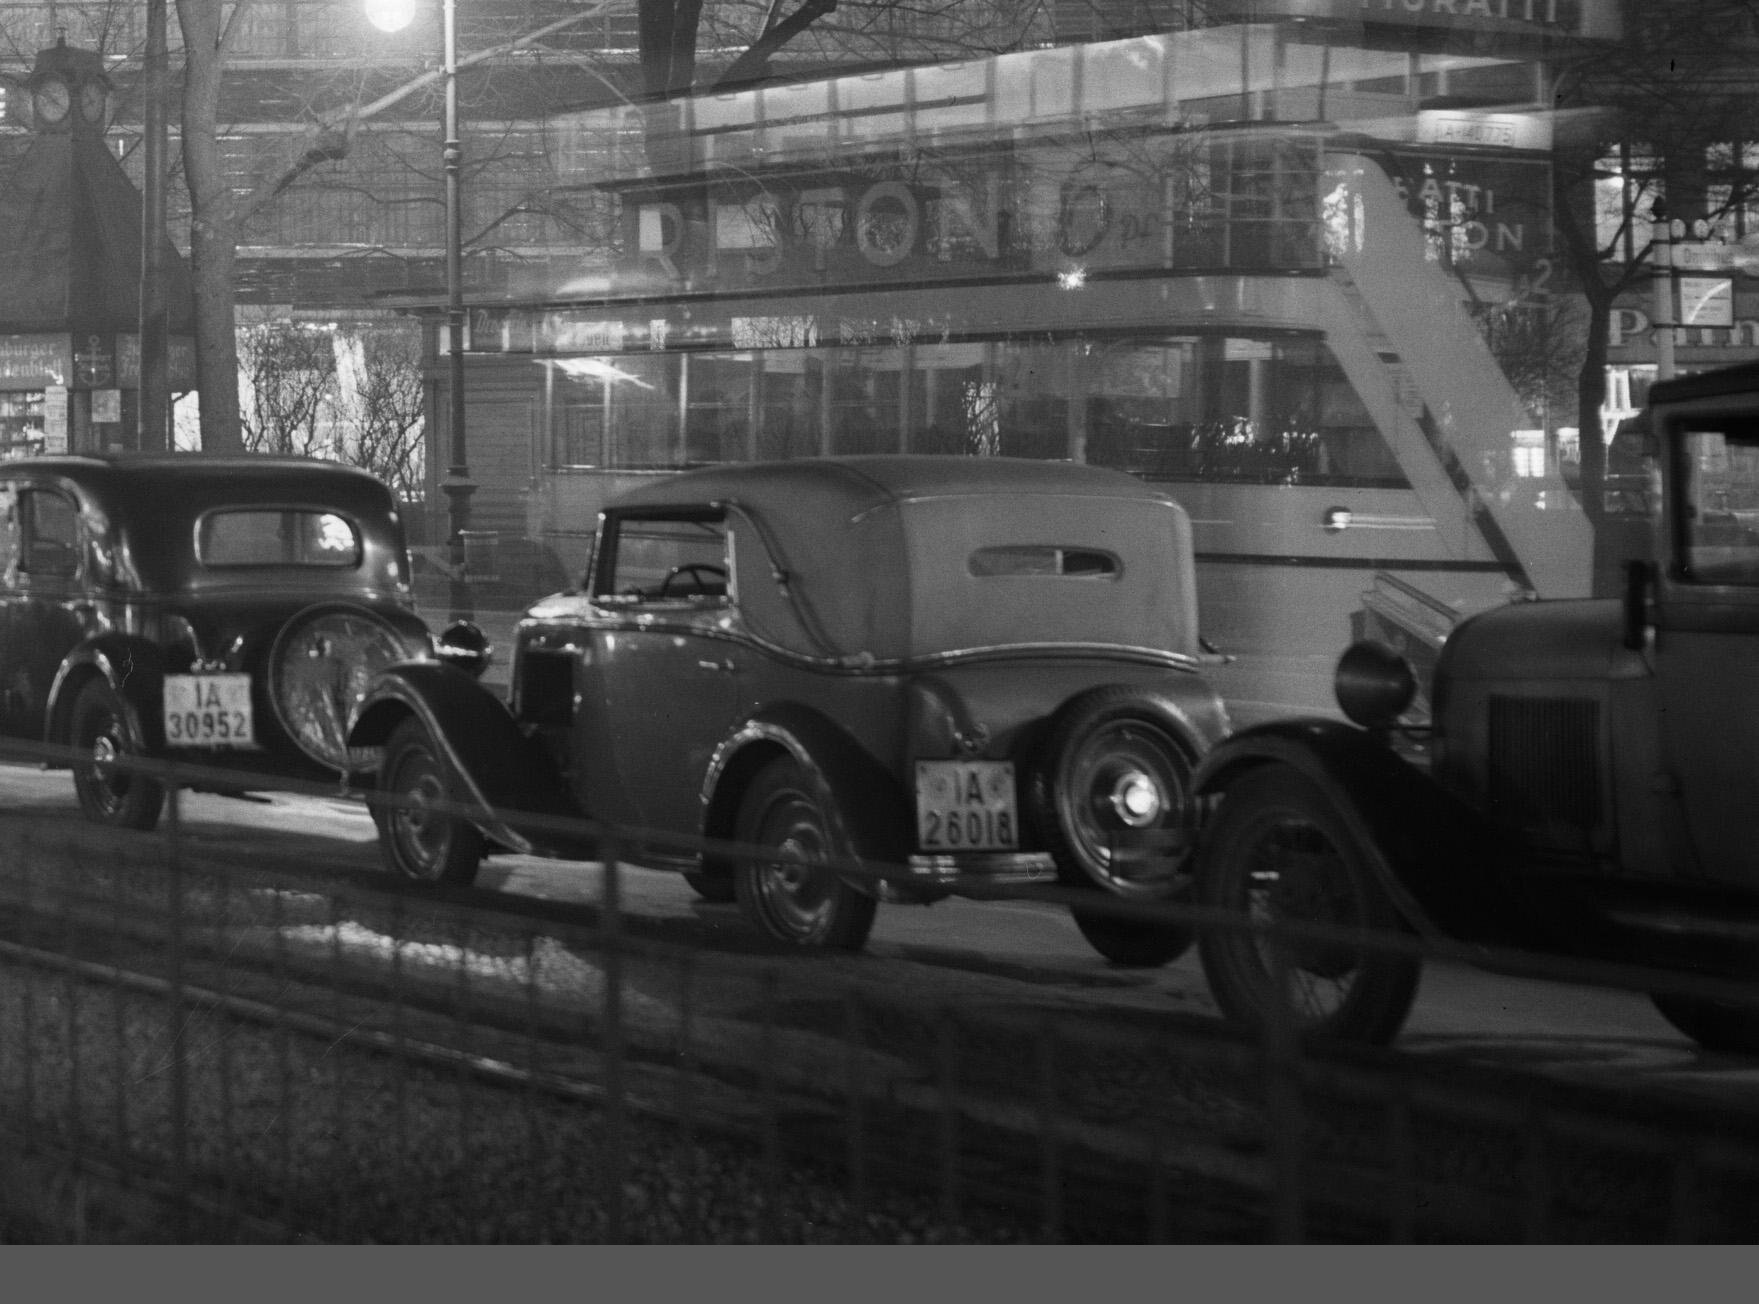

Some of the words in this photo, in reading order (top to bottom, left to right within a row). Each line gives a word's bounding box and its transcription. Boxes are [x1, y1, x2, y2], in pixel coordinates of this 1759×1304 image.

[196, 680, 221, 709] IA
[169, 712, 247, 738] 30952
[954, 770, 985, 806] IA
[923, 810, 1012, 845] 26018
